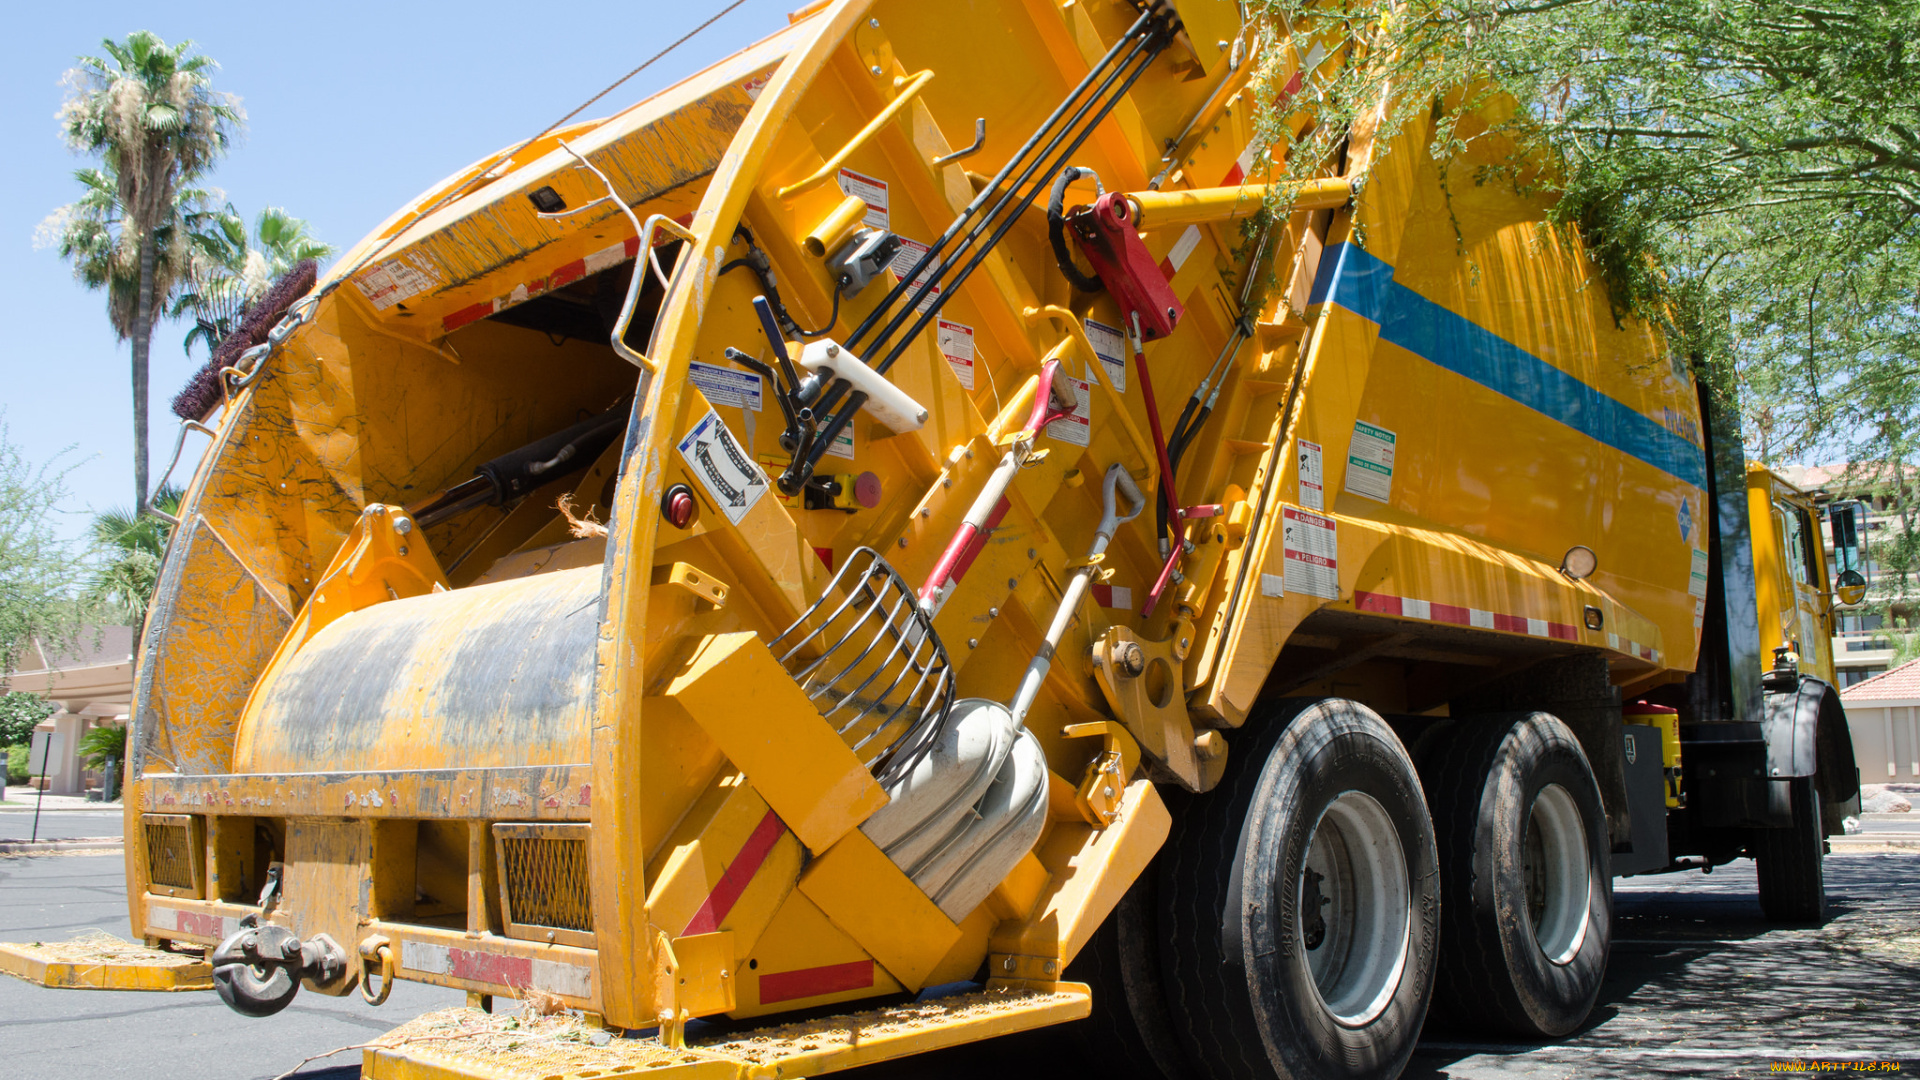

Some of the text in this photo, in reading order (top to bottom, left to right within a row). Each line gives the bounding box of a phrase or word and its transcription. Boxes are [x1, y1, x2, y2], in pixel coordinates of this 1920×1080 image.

[911, 242, 927, 252] DANGER
[950, 326, 967, 334] DANGER
[951, 357, 967, 365] PELIGRO
[1356, 424, 1374, 434] SAFETY
[1300, 514, 1326, 528] DANGER
[1301, 553, 1327, 566] PELIGRO
